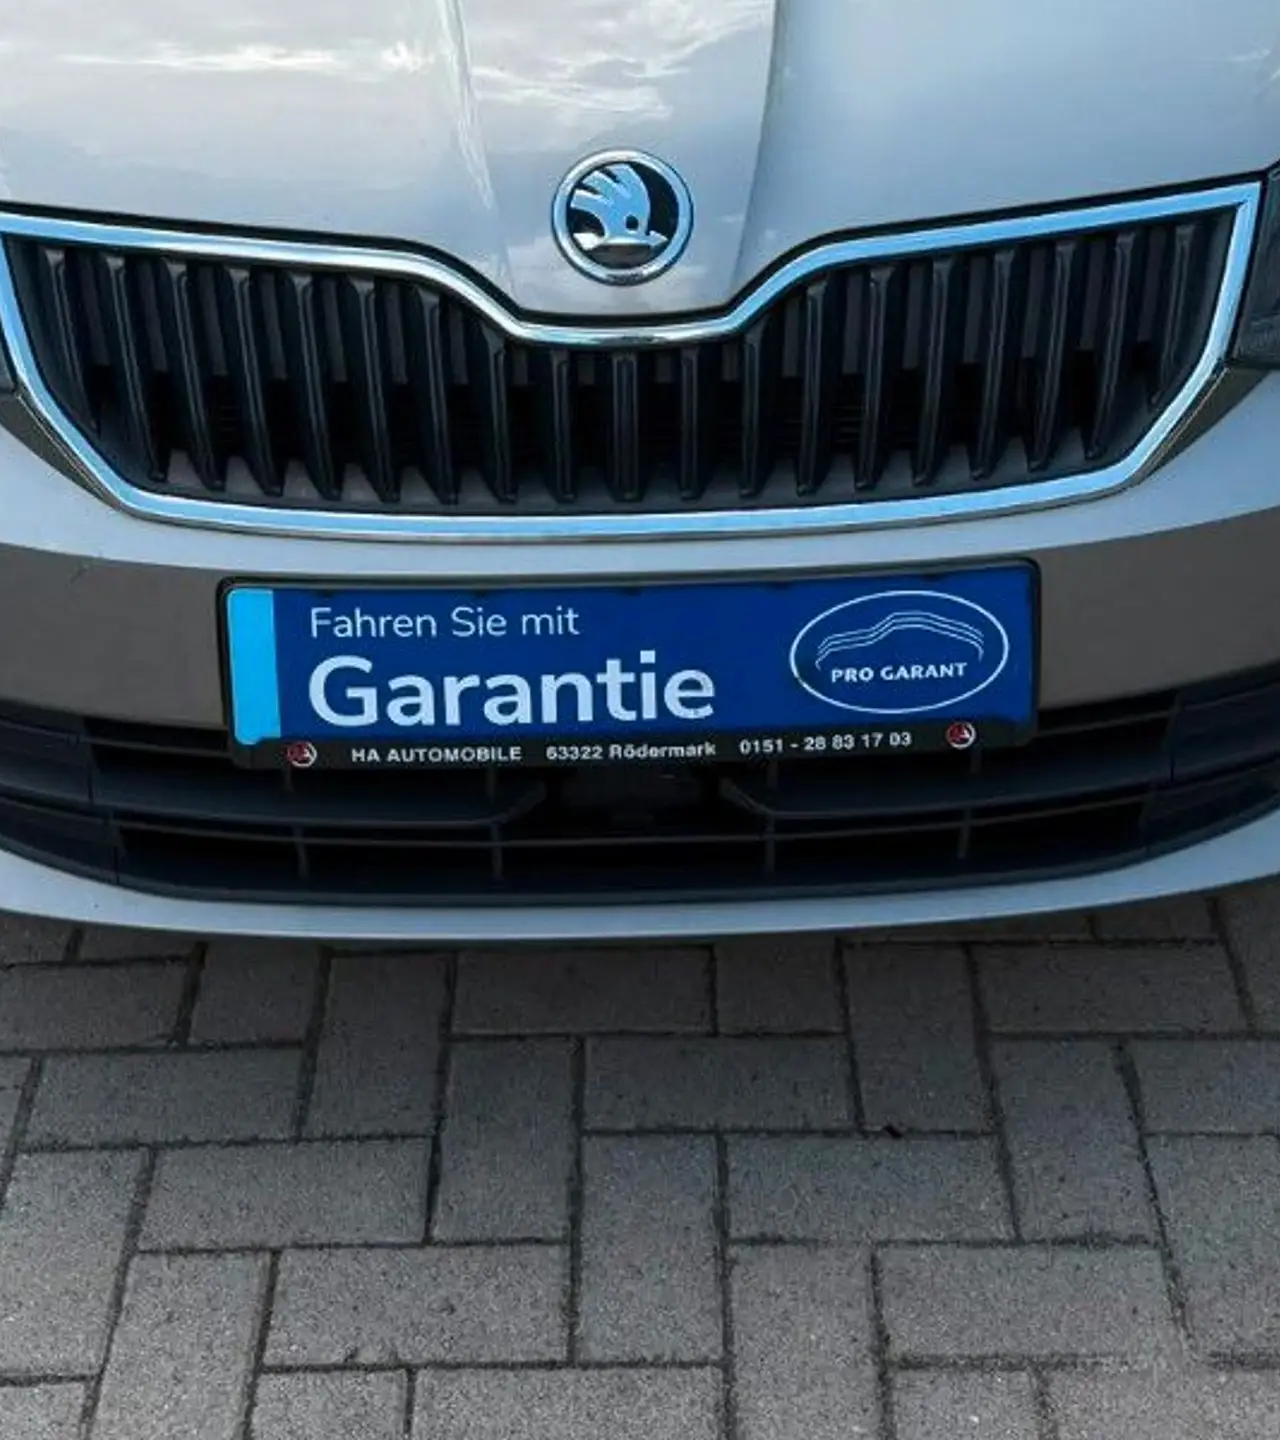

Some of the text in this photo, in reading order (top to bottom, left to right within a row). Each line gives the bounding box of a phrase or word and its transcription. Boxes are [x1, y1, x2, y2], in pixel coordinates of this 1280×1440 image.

[310, 605, 580, 638] Fahren Sie mit
[308, 649, 716, 728] Garantie
[831, 662, 967, 683] PRO GARANT
[351, 747, 380, 762] HA
[387, 746, 522, 762] AUTOMOBILE
[546, 746, 603, 760] 63322
[608, 742, 716, 759] Rödermark
[739, 739, 784, 755] 0151
[804, 736, 826, 751] 28
[832, 734, 855, 750] 83
[861, 732, 884, 747] 17
[889, 731, 913, 746] 03
